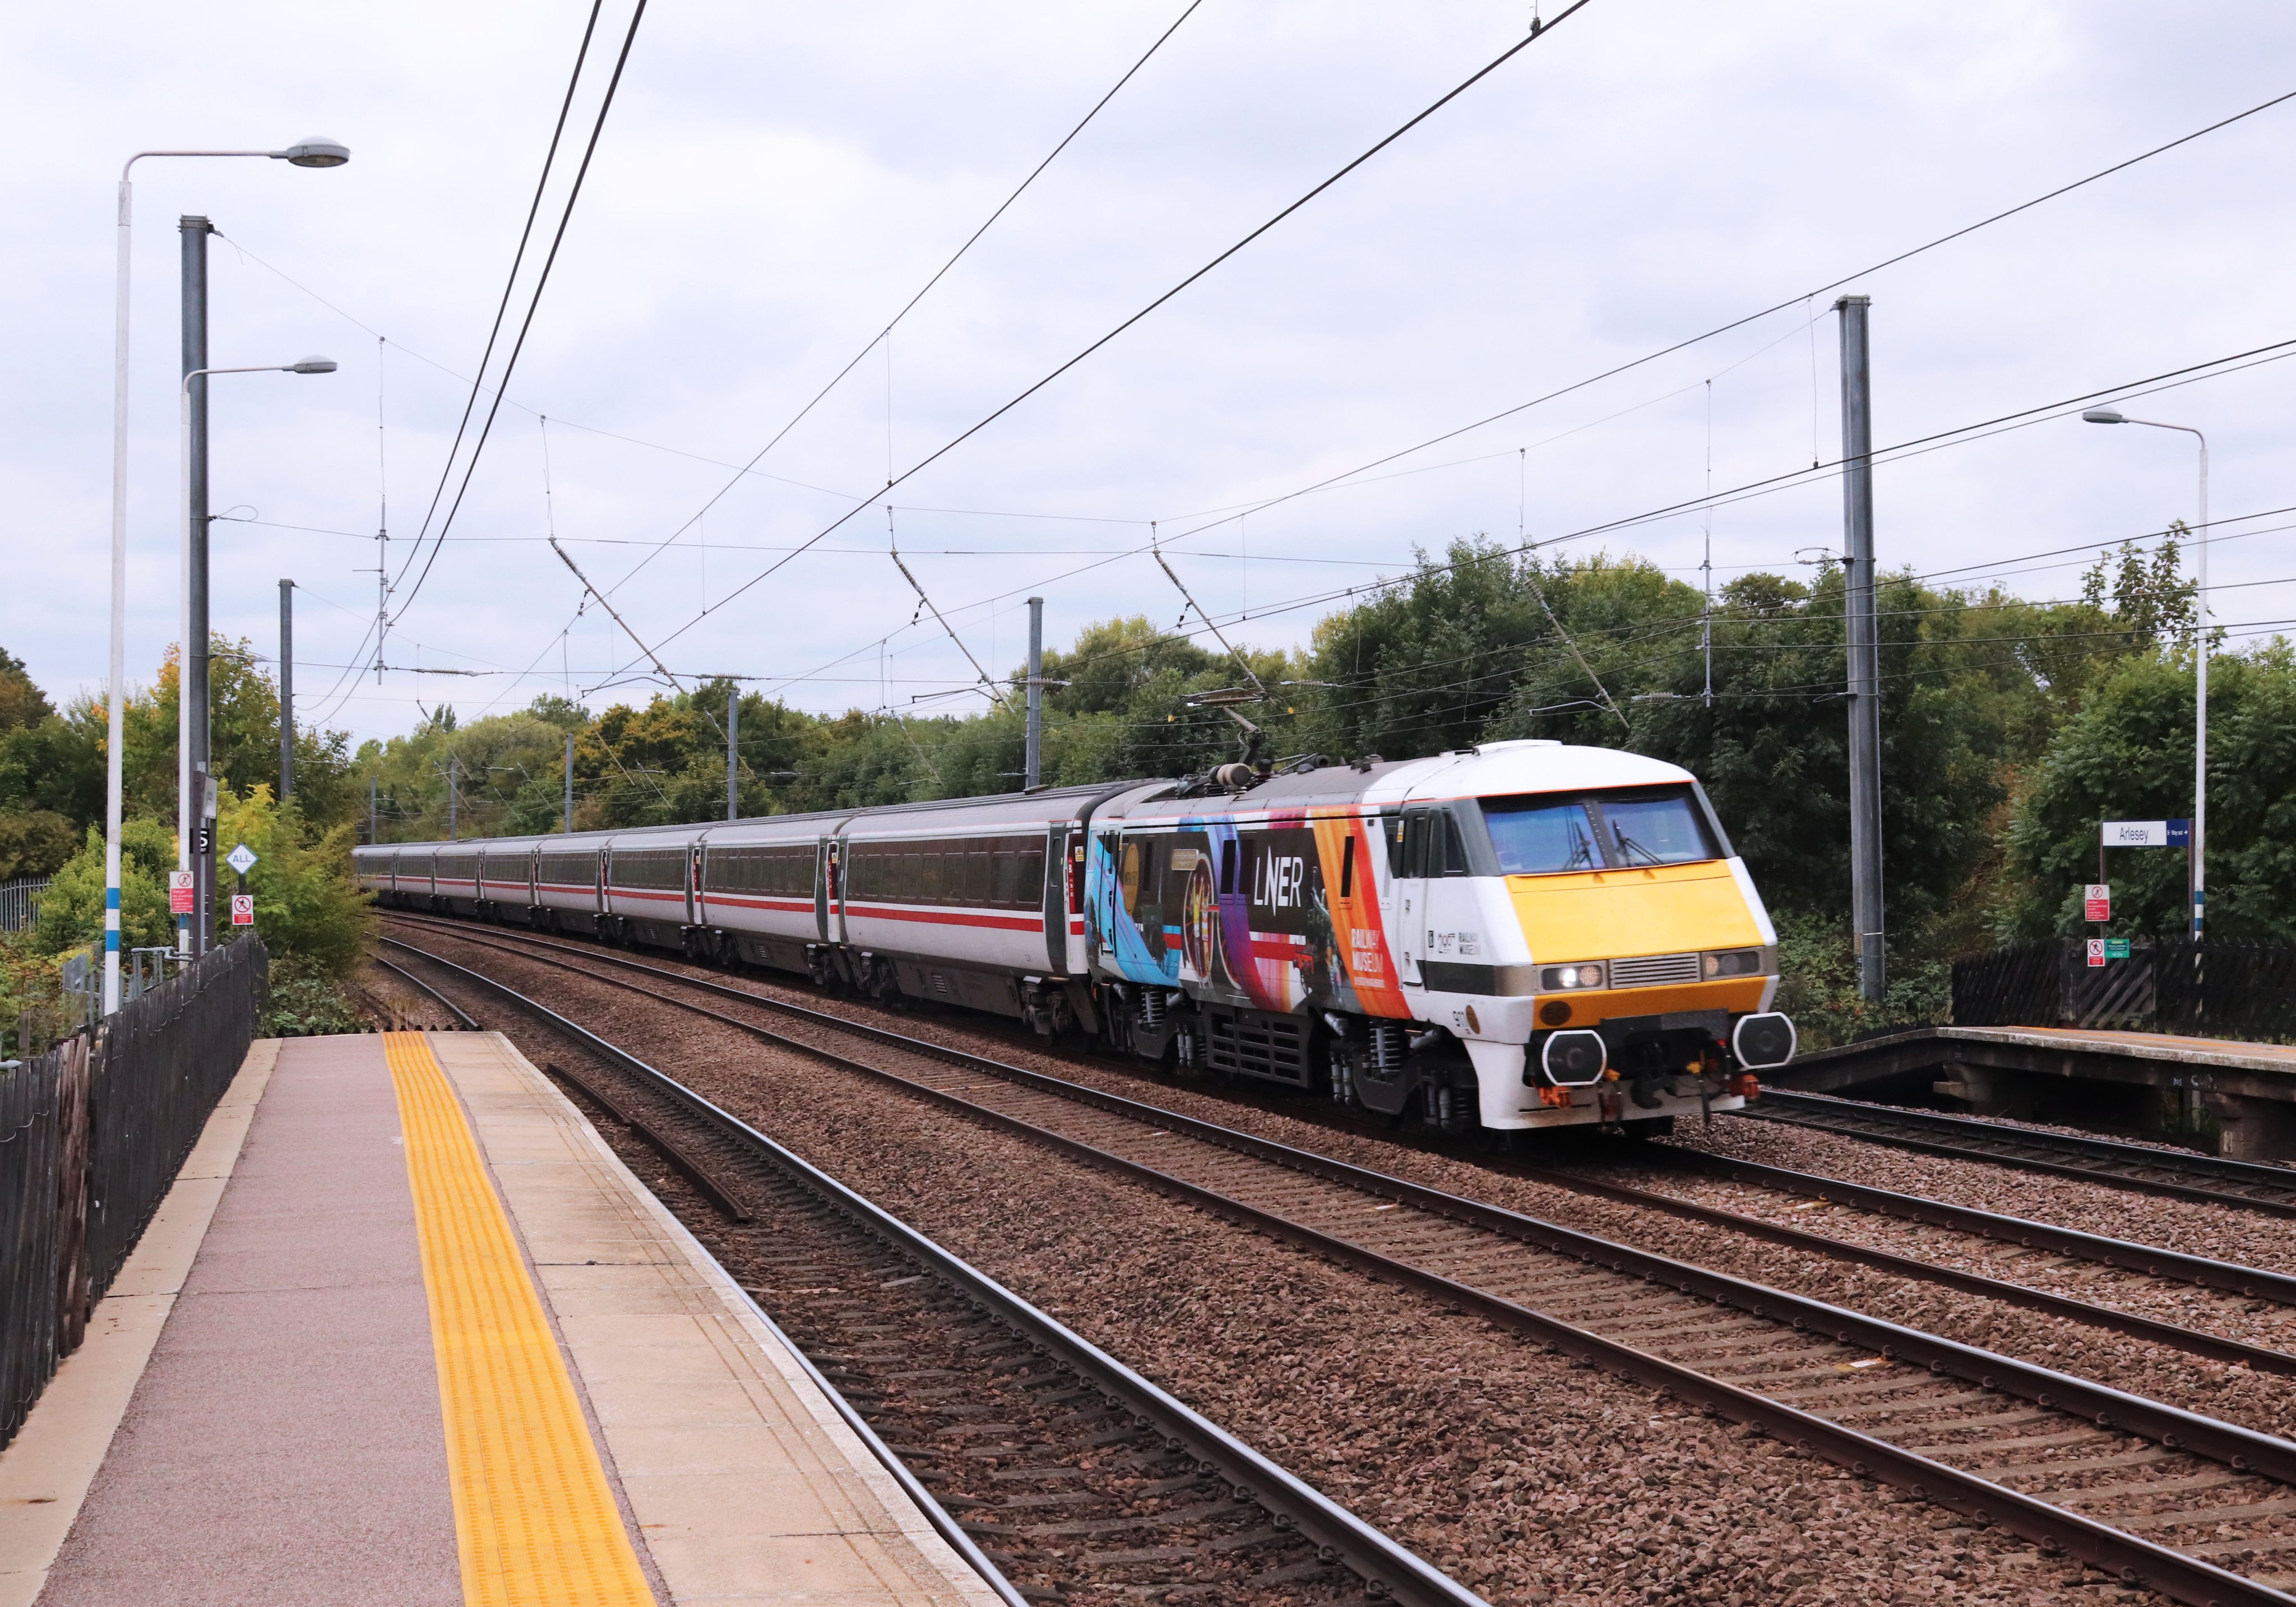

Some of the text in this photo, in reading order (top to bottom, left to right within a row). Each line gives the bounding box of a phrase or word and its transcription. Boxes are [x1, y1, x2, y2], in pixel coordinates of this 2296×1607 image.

[2119, 827, 2149, 844] Arlesey
[1254, 845, 1303, 917] LNER
[1352, 951, 1383, 972] MUSEUM
